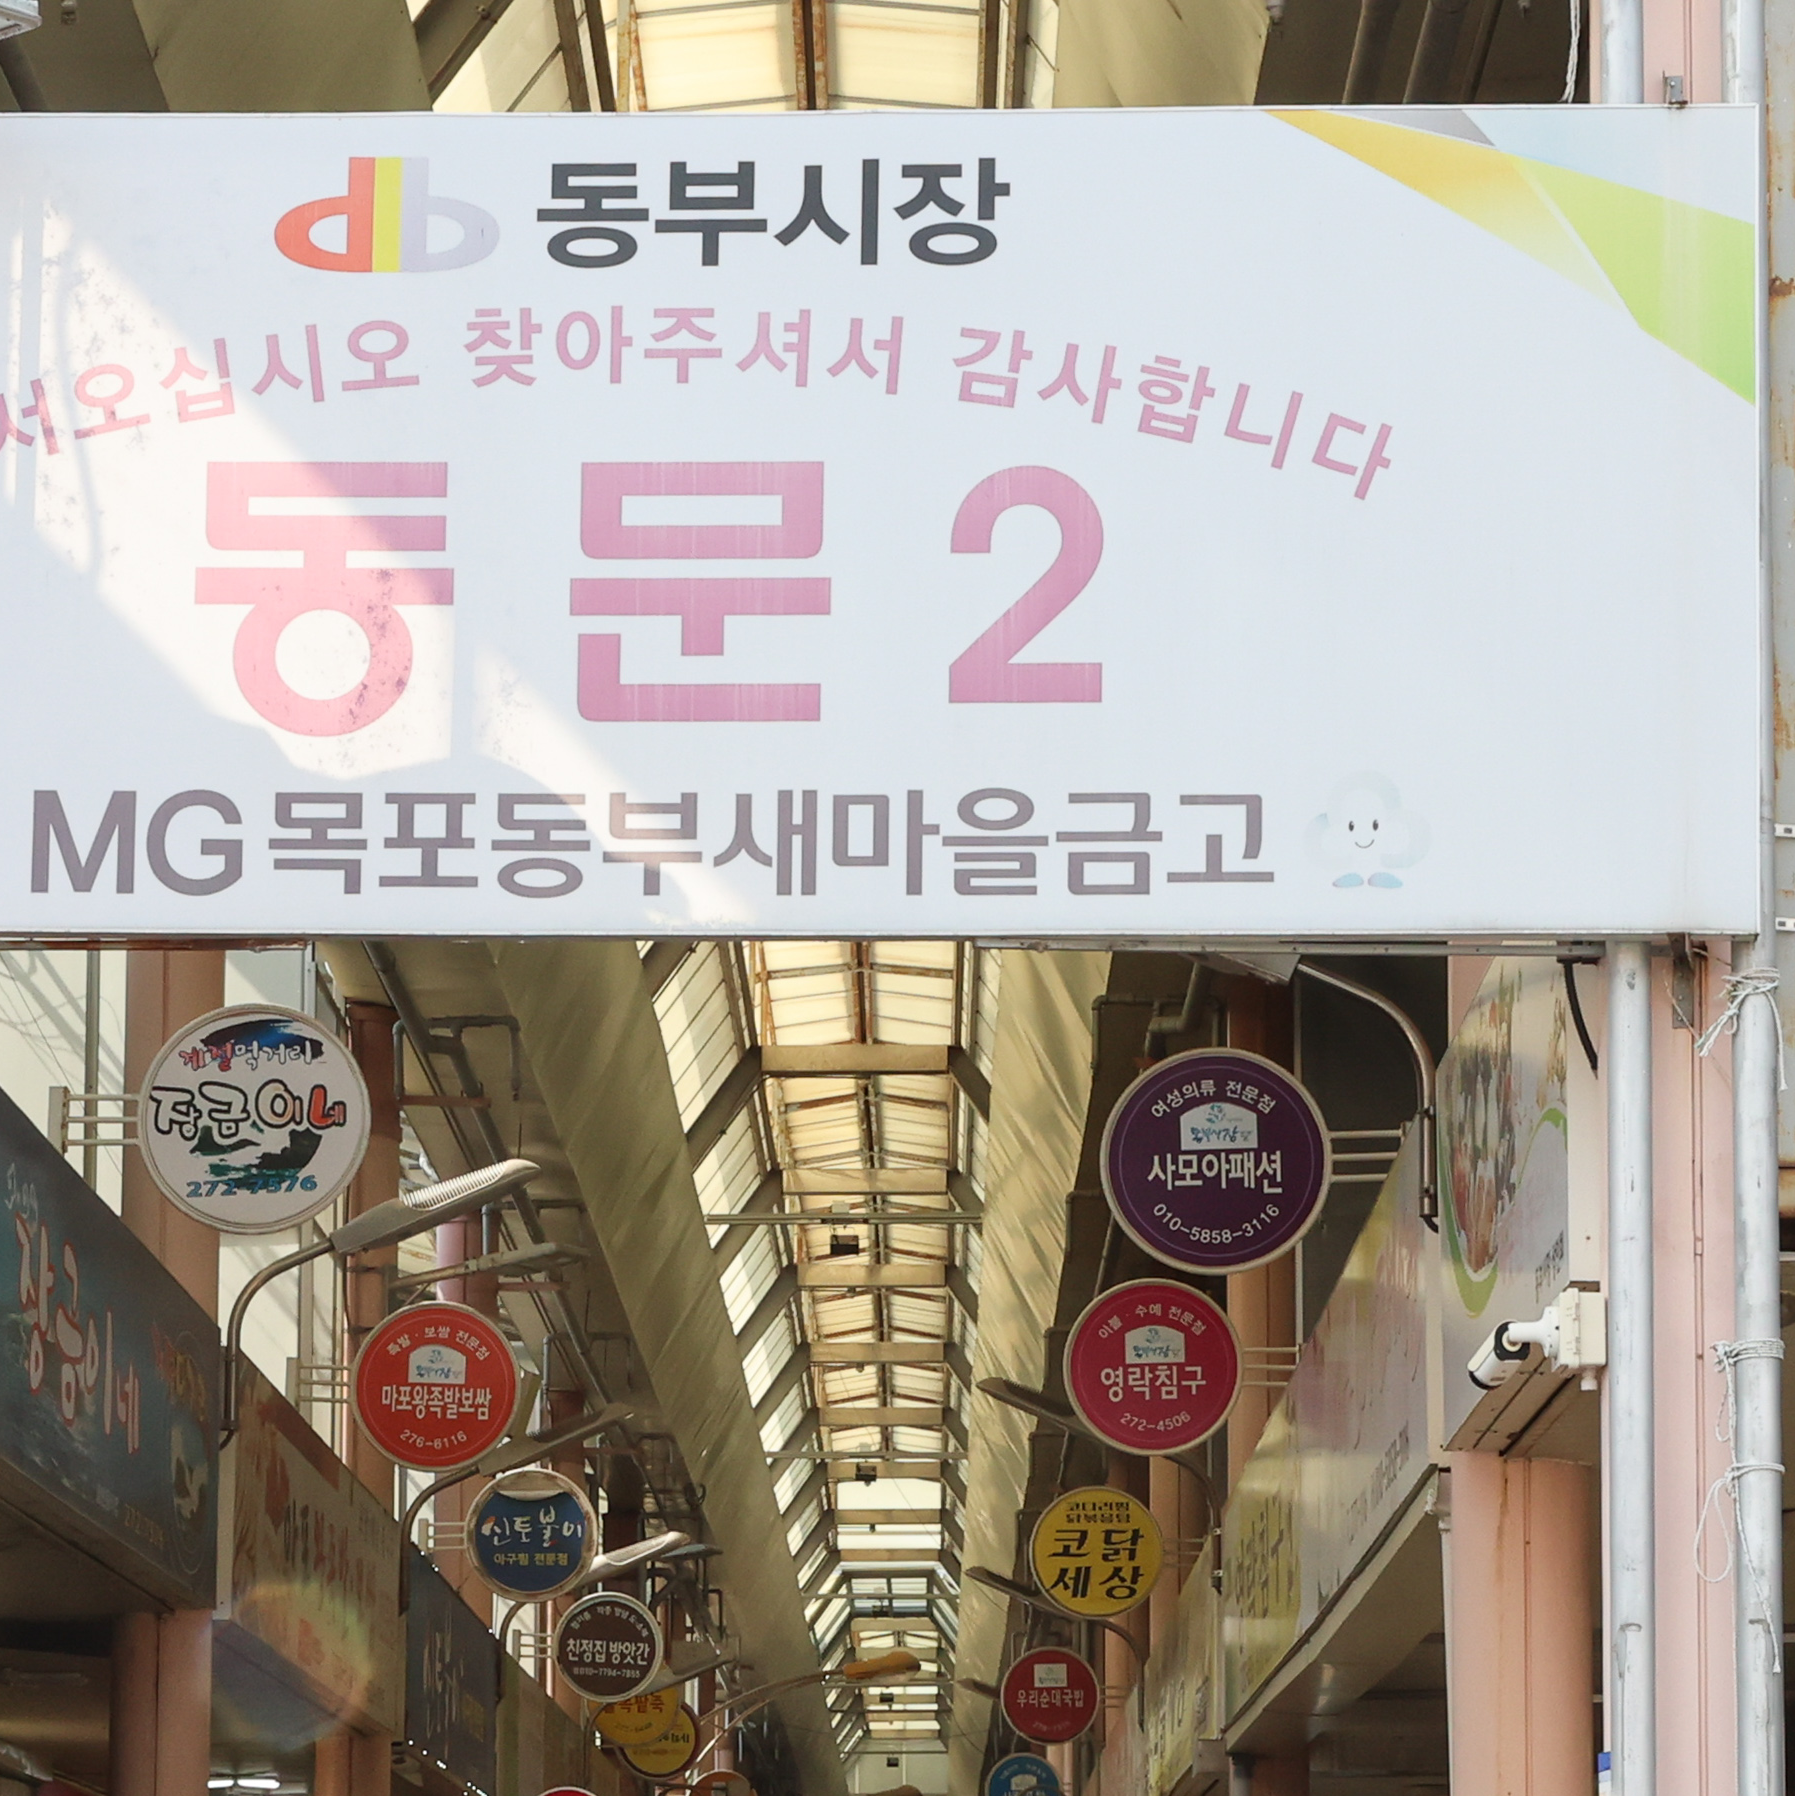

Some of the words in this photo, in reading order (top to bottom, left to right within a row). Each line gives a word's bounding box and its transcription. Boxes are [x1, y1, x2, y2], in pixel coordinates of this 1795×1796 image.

[534, 153, 1010, 271] 동부시장
[461, 304, 907, 394] 찾아주셔서
[951, 321, 1404, 505] 감사합니다
[947, 463, 1105, 707] 2
[1151, 1079, 1217, 1118] 여성의류
[1225, 1080, 1277, 1115] 전문점
[1147, 1151, 1283, 1194] 사모아패션
[1153, 1203, 1281, 1245] 010-5858-3116
[381, 1385, 492, 1421] 마포왕족발보쌈
[1101, 1366, 1206, 1404] 영락침구
[400, 1429, 467, 1450] 276-6116
[481, 1505, 582, 1548] 신토불이
[566, 1638, 607, 1662] 친정집
[609, 1640, 651, 1666] 방앗간
[1016, 1690, 1084, 1708] 우리순대국밥
